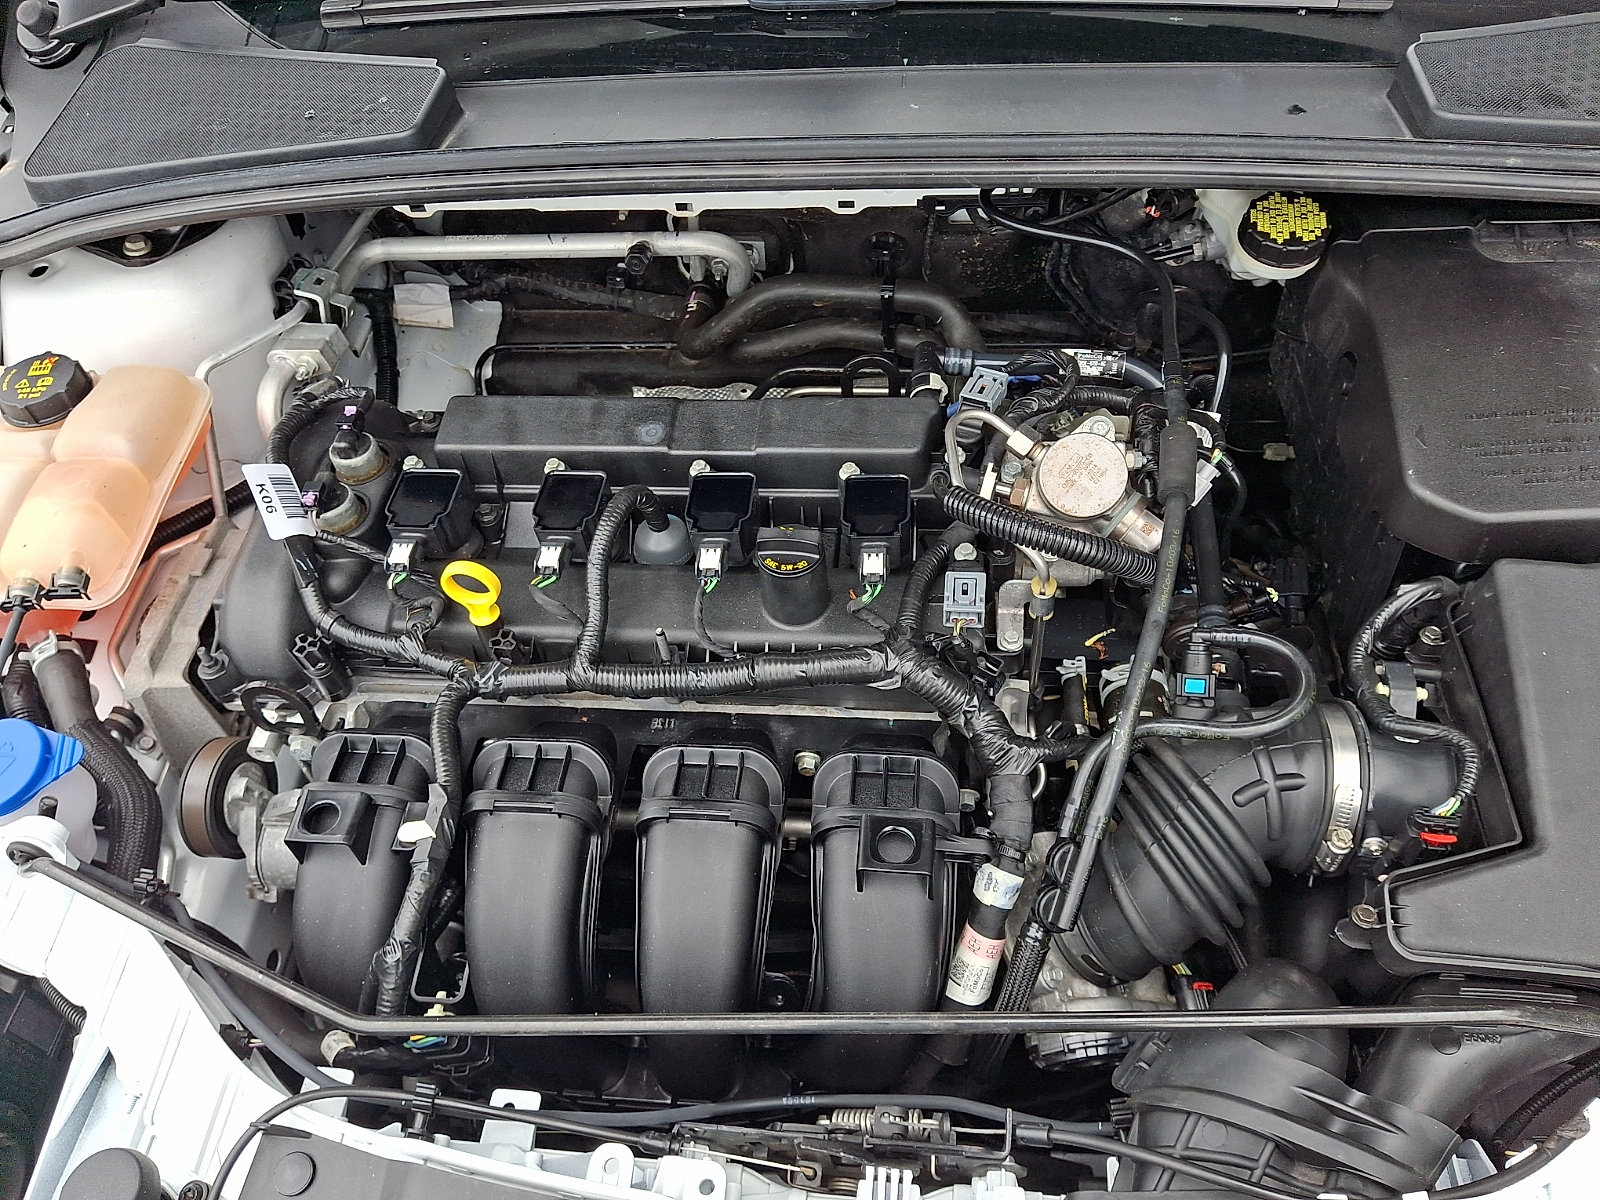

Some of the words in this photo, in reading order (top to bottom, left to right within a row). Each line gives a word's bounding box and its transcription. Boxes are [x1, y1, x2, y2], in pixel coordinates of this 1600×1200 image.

[256, 484, 277, 514] K06
[765, 558, 778, 569] SAE
[781, 561, 808, 570] 5W-20
[967, 935, 979, 954] AEH
[985, 944, 997, 958] AEH
[970, 968, 983, 993] FoMoCo
